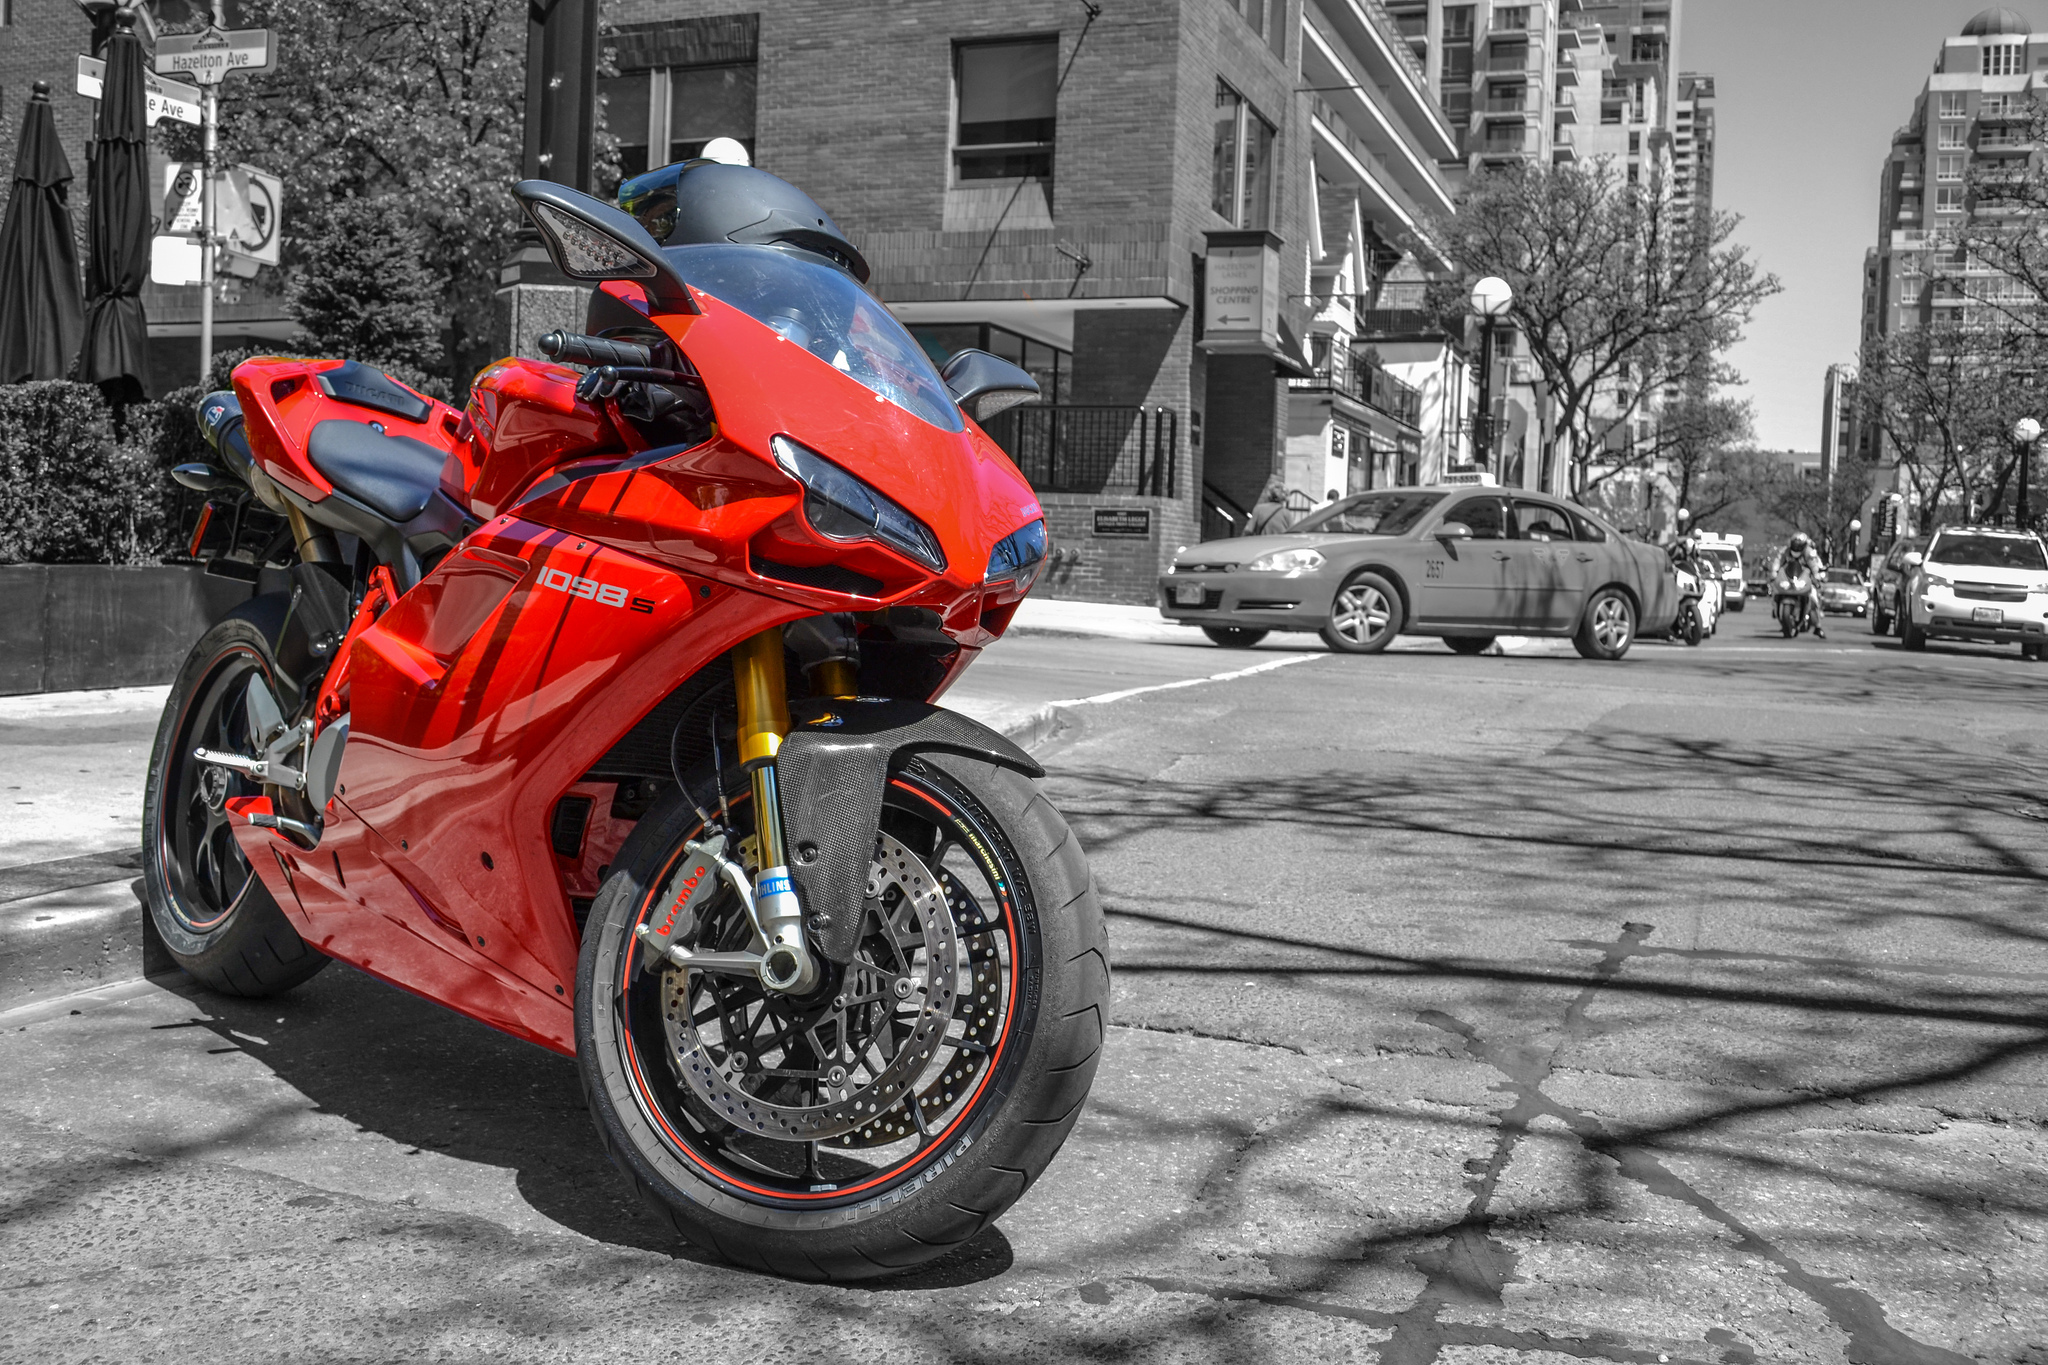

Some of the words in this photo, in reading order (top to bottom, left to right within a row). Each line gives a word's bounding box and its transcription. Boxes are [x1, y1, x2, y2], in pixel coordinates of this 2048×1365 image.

[172, 54, 223, 71] Hazelton
[226, 52, 249, 66] Ave
[161, 99, 184, 118] Ave
[1210, 285, 1259, 295] SHOPPING
[1216, 295, 1252, 305] CENTRE
[1426, 559, 1445, 579] 2657
[535, 565, 629, 608] 1098
[629, 597, 656, 614] S
[968, 832, 1002, 881] marchesini
[655, 865, 706, 937] brembo
[845, 1134, 975, 1222] PIRELLI
